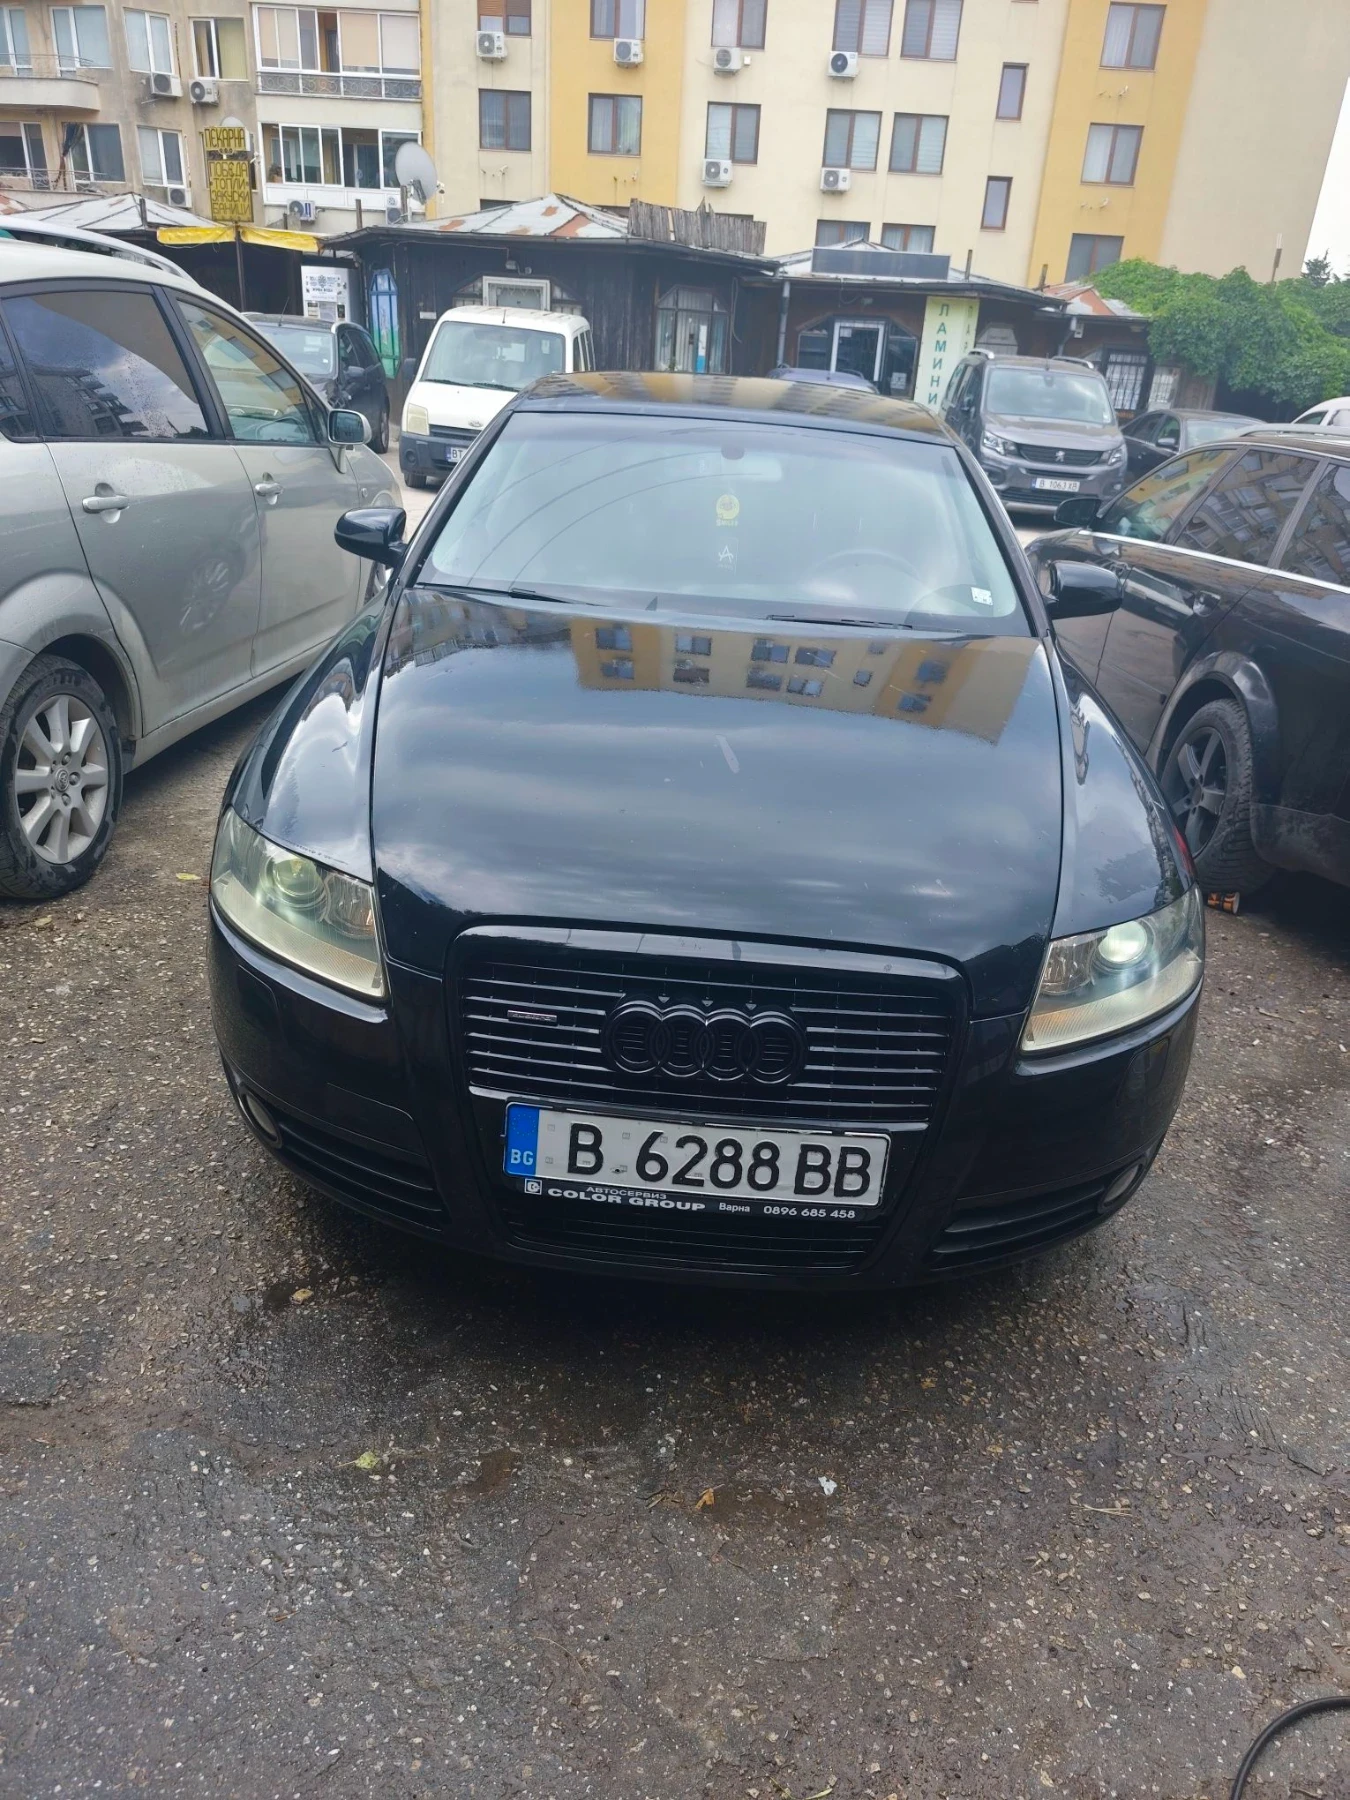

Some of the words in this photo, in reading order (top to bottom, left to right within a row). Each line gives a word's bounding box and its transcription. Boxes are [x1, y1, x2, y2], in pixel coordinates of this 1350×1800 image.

[204, 129, 246, 148] ПЕКАРНА
[209, 161, 248, 178] ПОБЕДА
[213, 177, 246, 190] ТОПЛИ
[211, 190, 250, 202] ЗАКУСКИ
[212, 202, 250, 215] БАНИЦИ
[510, 1149, 534, 1165] BG
[567, 1122, 604, 1175] B
[636, 1130, 780, 1191] 6288
[794, 1143, 871, 1197] BB
[548, 1188, 622, 1204] COLOR
[628, 1197, 706, 1212] GROUP
[586, 1186, 667, 1200] АВТОСЕРВИЗ
[719, 1202, 751, 1213] Варна
[763, 1205, 798, 1216] 0896
[801, 1208, 827, 1218] 685
[830, 1209, 856, 1219] 458
